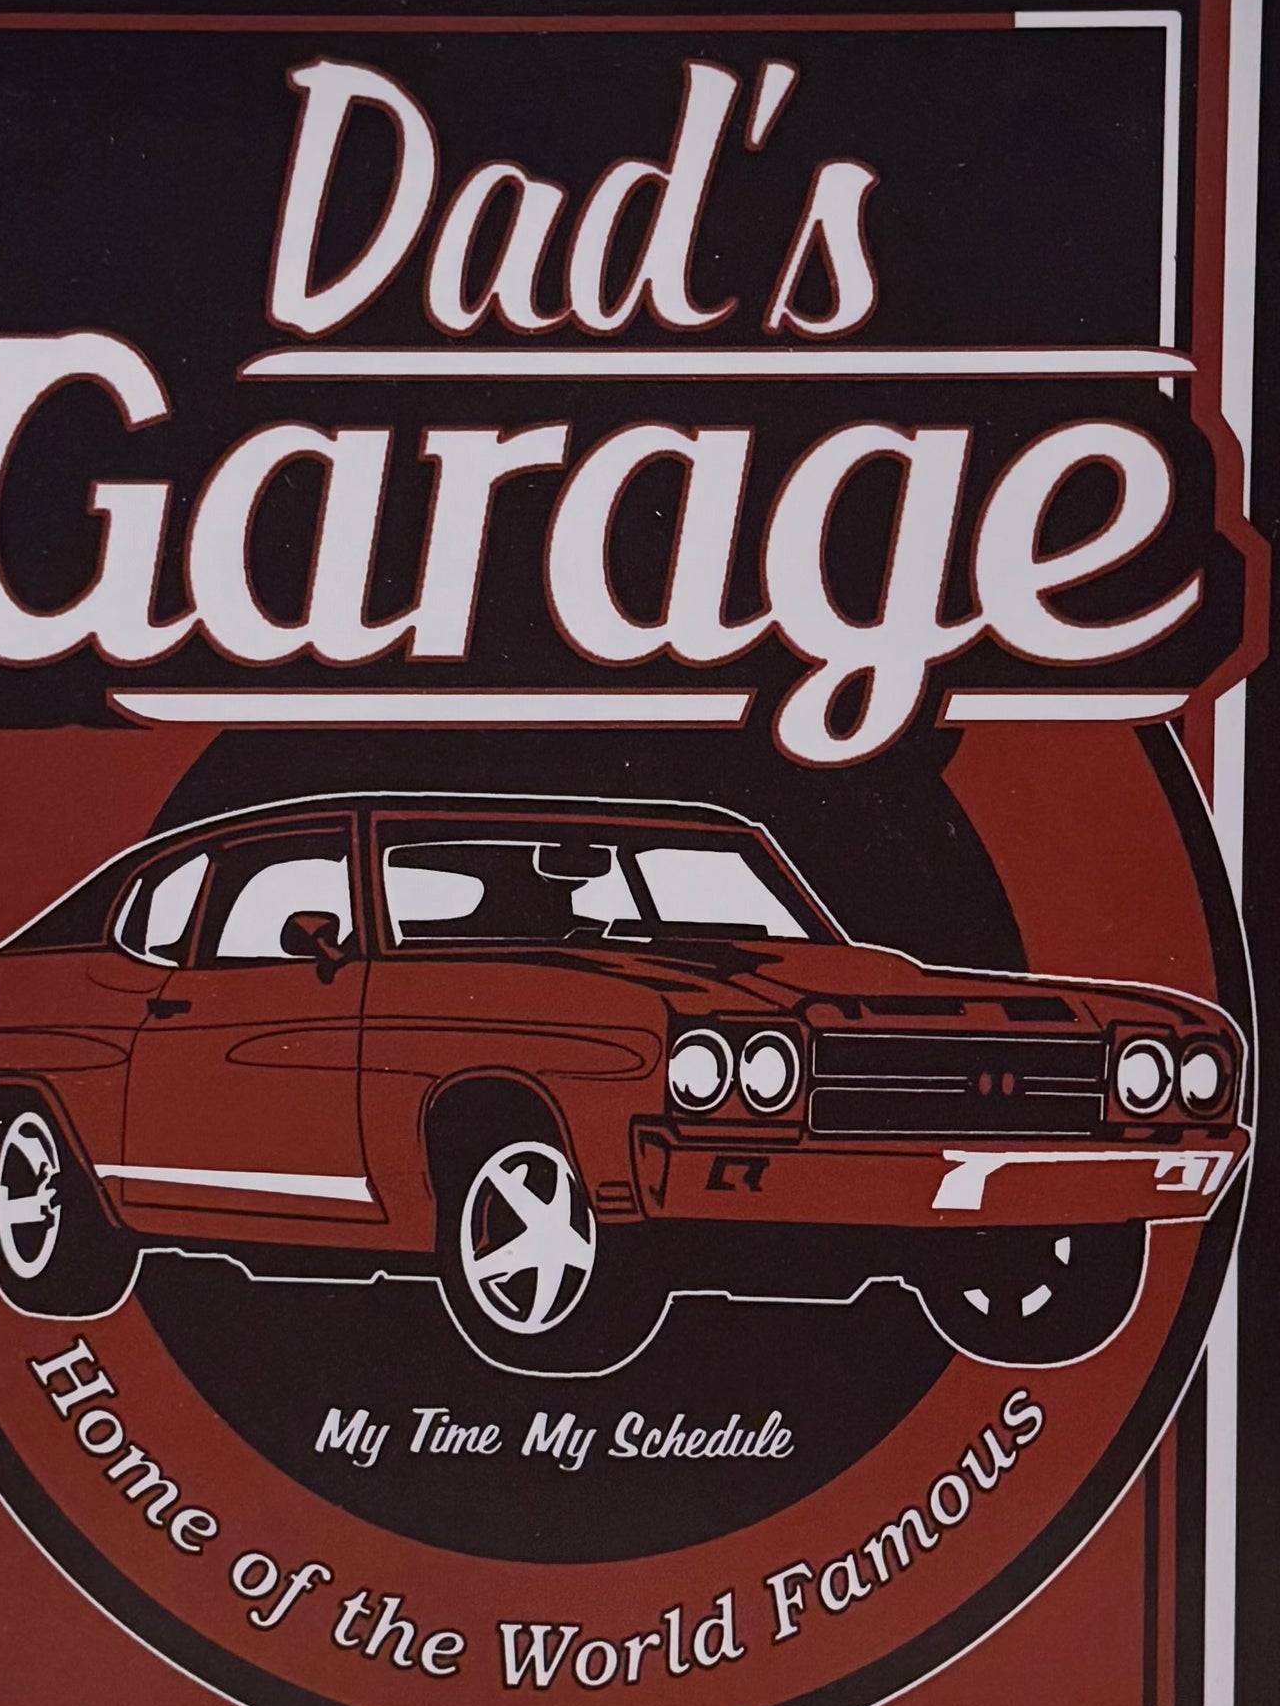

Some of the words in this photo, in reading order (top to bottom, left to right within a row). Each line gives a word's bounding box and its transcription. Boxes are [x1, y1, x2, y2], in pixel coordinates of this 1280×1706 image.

[268, 57, 878, 337] Dad's
[30, 1337, 220, 1555] Home
[229, 1547, 332, 1628] of
[333, 1587, 467, 1676] the
[498, 1593, 747, 1688] World
[765, 1387, 1045, 1642] Famous
[313, 1406, 392, 1469] My
[408, 1406, 505, 1456] Time
[520, 1410, 598, 1472] My
[606, 1409, 797, 1460] Schedule
